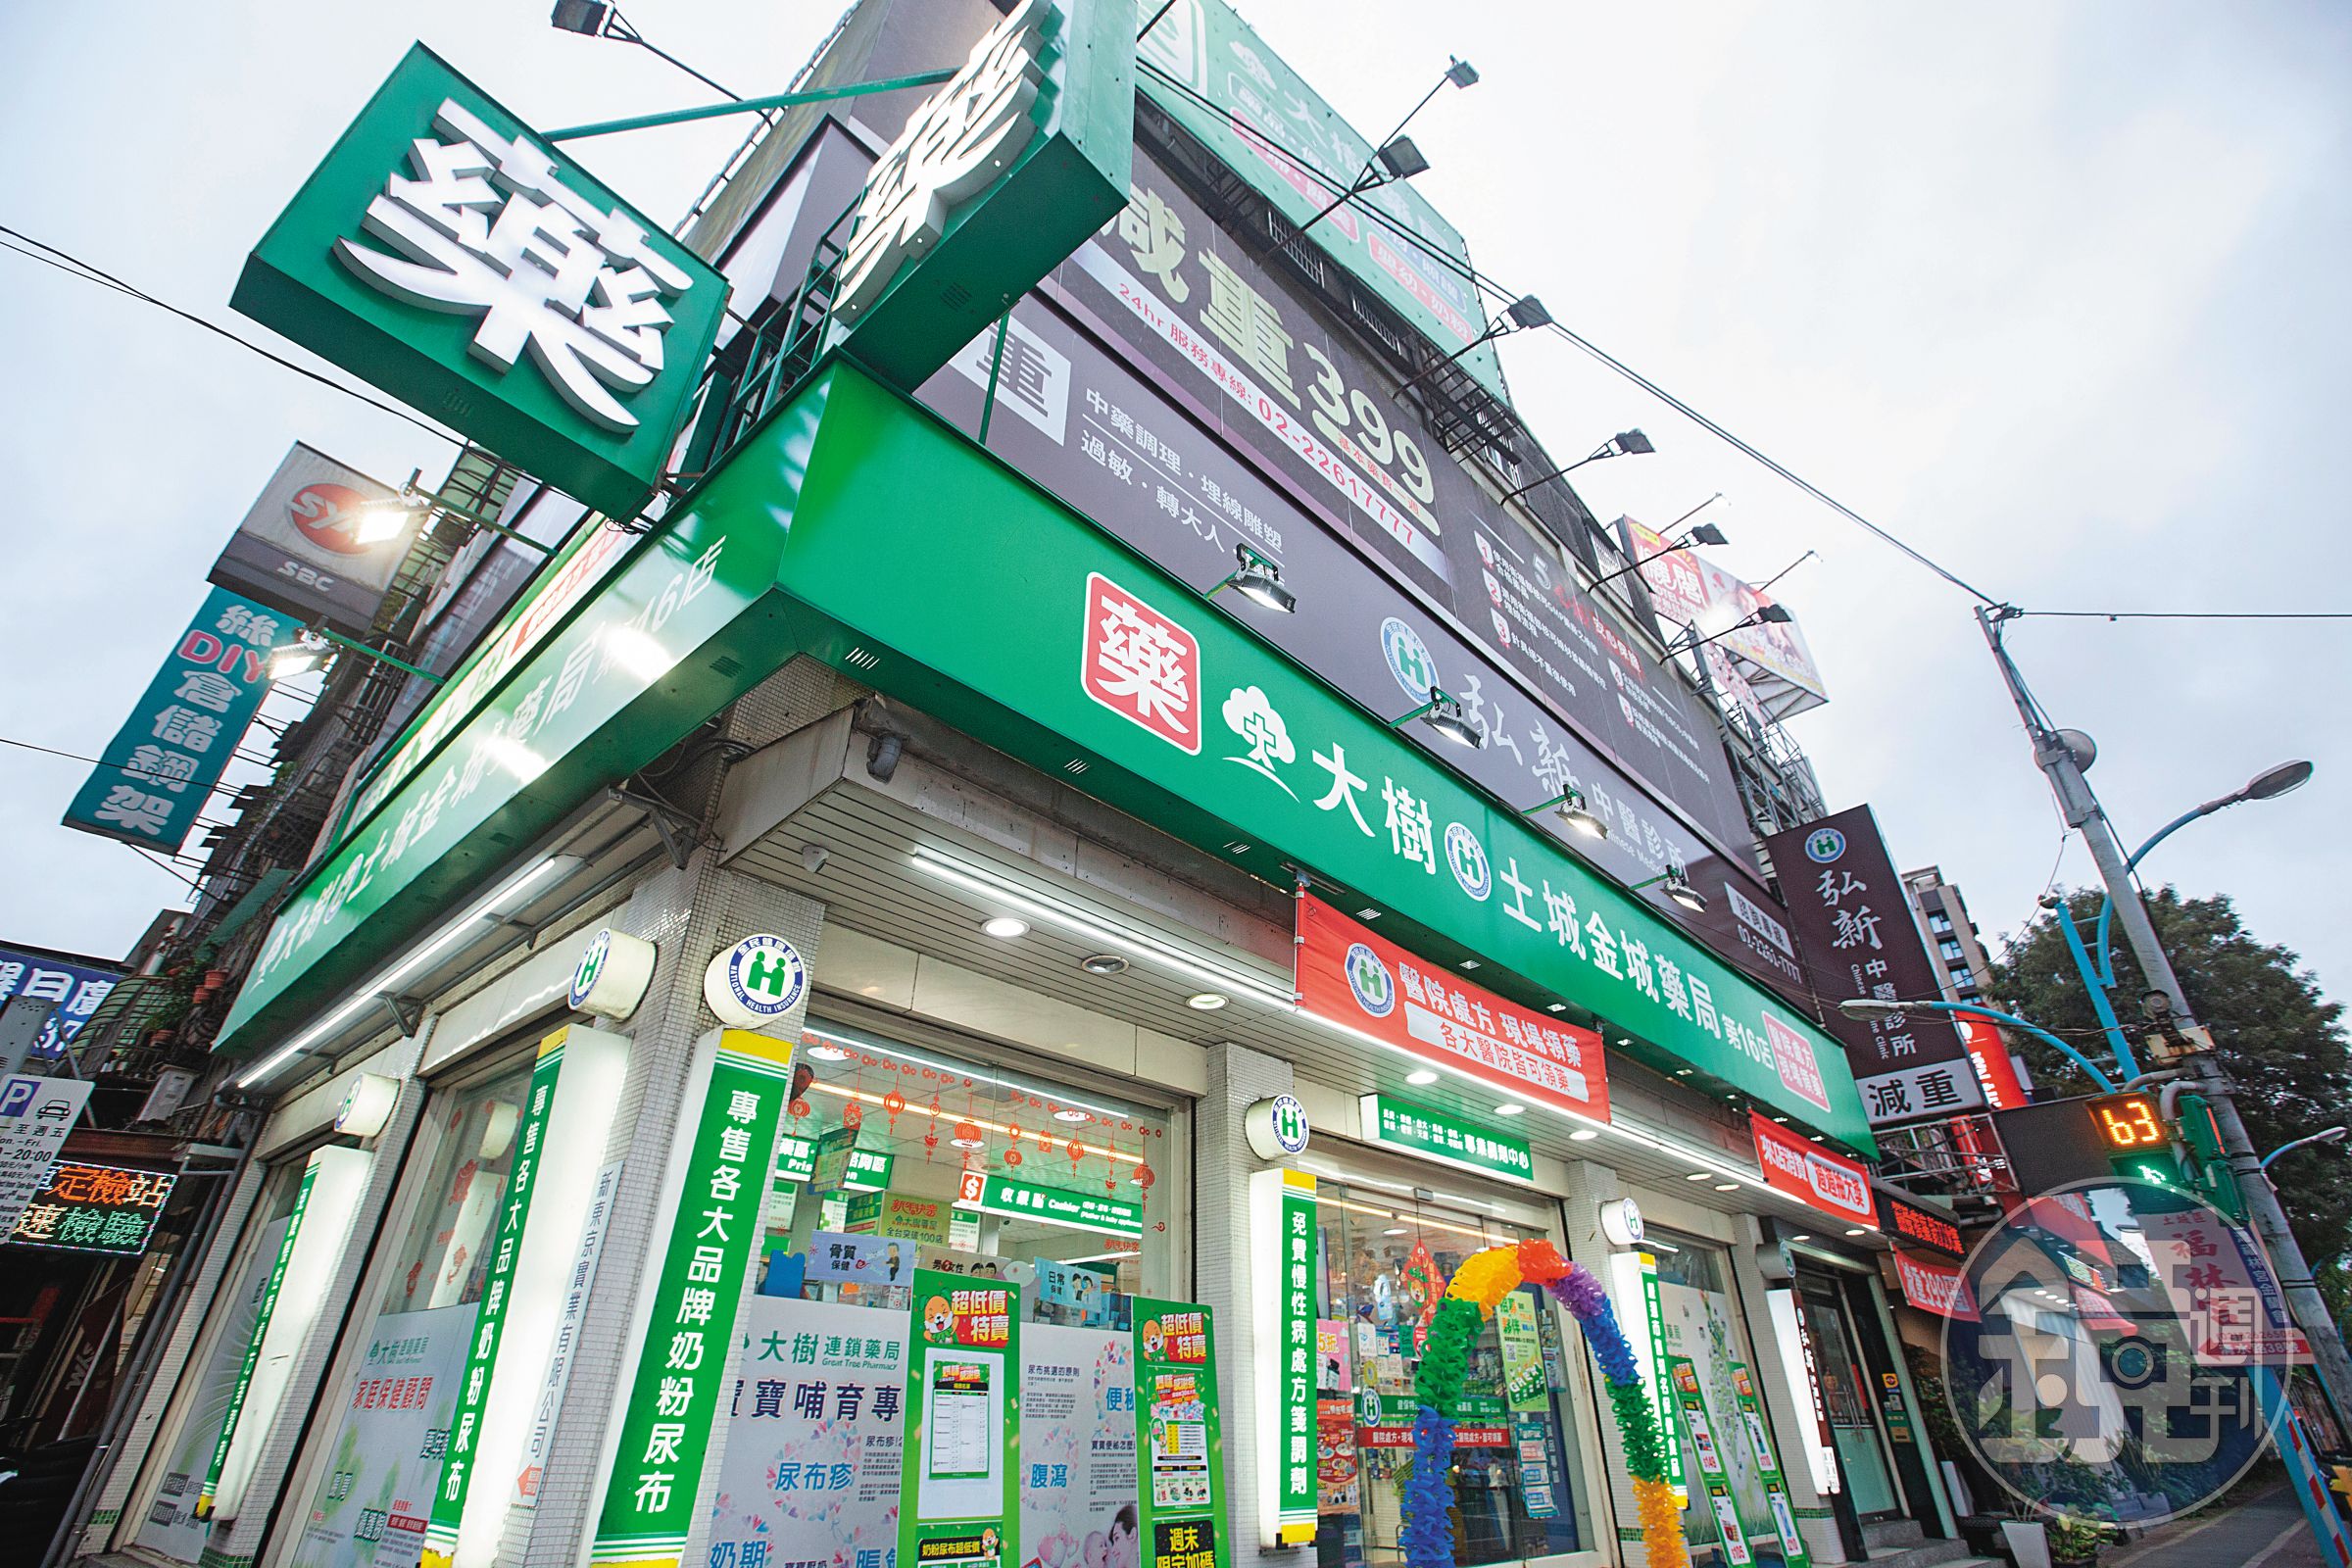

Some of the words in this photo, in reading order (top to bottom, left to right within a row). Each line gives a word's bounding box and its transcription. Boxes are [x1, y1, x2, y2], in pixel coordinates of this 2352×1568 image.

[332, 97, 694, 434] 藥
[1118, 284, 1164, 328] 24hr
[1258, 398, 1414, 545] 02-22617777
[278, 562, 338, 594] SBC
[1096, 595, 1190, 734] 藥
[1312, 742, 1437, 874] 大樹
[1500, 857, 1722, 1040] 土城金城藥局
[1721, 1013, 1776, 1071] 第16店
[1816, 869, 1883, 950] 弘新
[729, 964, 745, 1002] NATIONAL
[746, 999, 772, 1014] HEALTH
[773, 983, 803, 1013] INSURANCE
[1398, 962, 1496, 1035] 醫院處方
[1498, 1011, 1583, 1067] 現場領藥
[1440, 1022, 1571, 1092] 各大醫院皆可領藥
[1, 1082, 32, 1117] P
[1867, 1069, 1963, 1117] 減重
[2101, 1101, 2160, 1146] 63
[829, 1243, 858, 1261] 骨質
[831, 1259, 851, 1272] 保健
[446, 1085, 550, 1503] 專售各大品牌奶粉尿布
[633, 1090, 760, 1514] 專售各大品牌奶粉尿布
[951, 1289, 1007, 1316] 超低價
[529, 1171, 612, 1460] 新東京實業有限公司
[969, 1314, 1010, 1343] 特賣
[1160, 1311, 1203, 1337] 超低價
[758, 1330, 819, 1365] 大樹
[823, 1335, 901, 1361] 連鎖藥局
[822, 1357, 843, 1368] Great
[845, 1358, 861, 1368] Tree
[862, 1360, 898, 1371] Pharmacy
[1177, 1334, 1207, 1360] 特賣
[1290, 1211, 1308, 1495] 免費慢性病處方箋調劑
[354, 1376, 434, 1411] 家庭保健顧問
[775, 1461, 854, 1492] 尿布疹
[1030, 1462, 1069, 1489] 腹瀉
[1170, 1527, 1200, 1552] 週末
